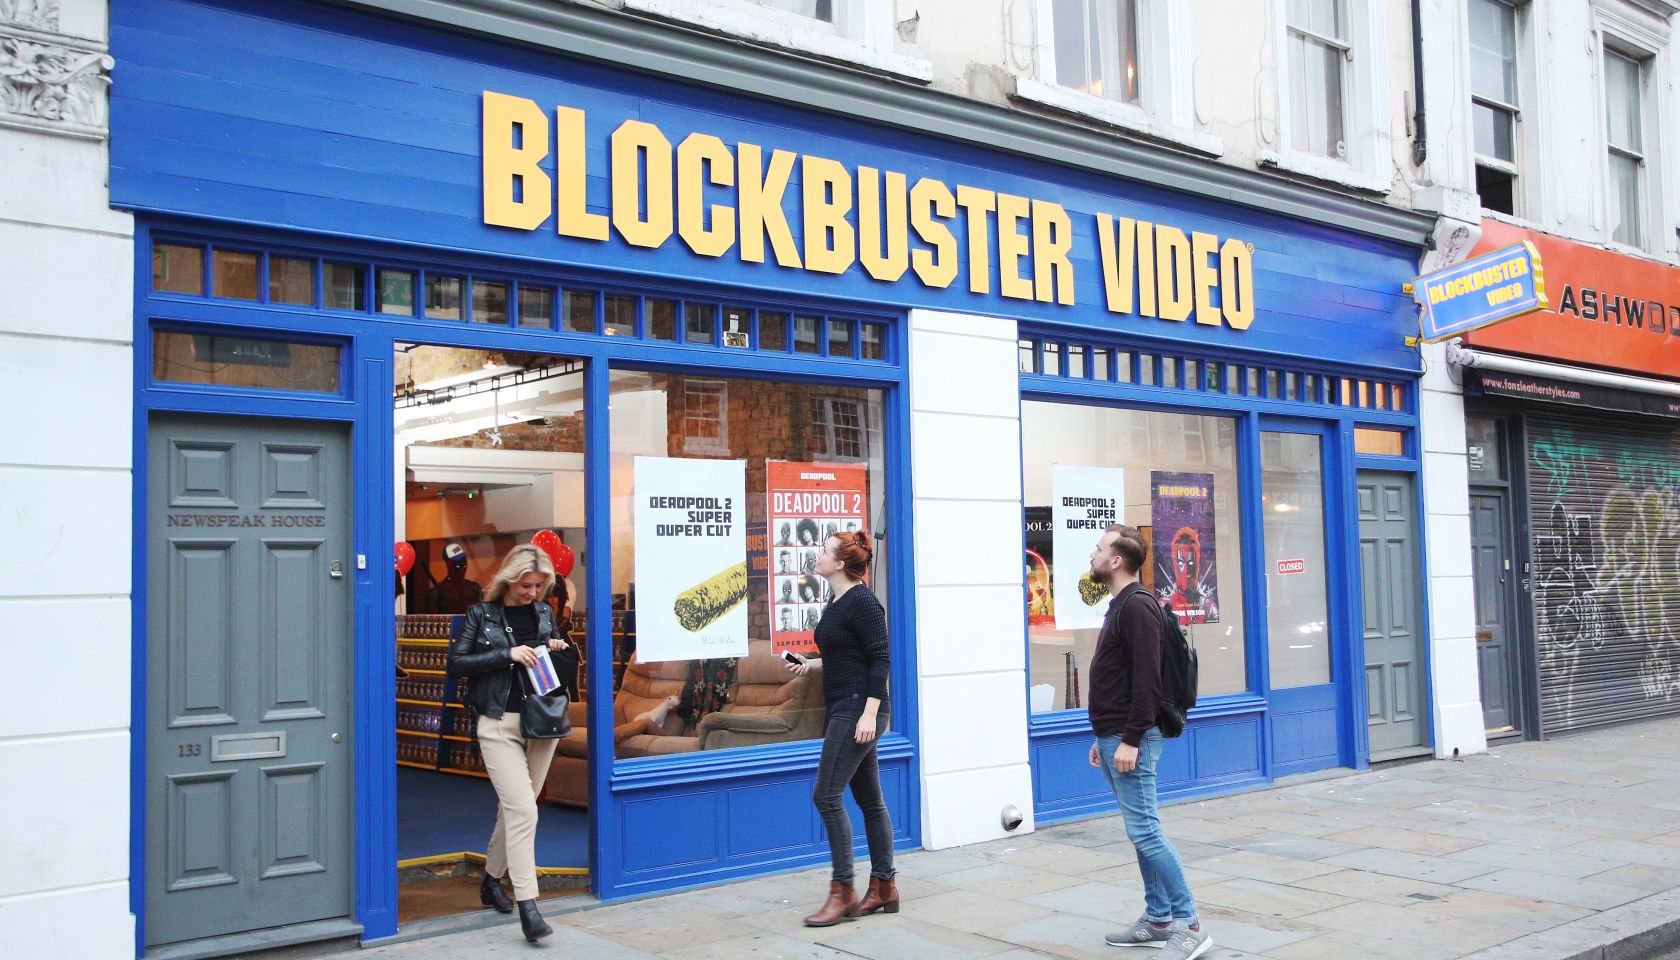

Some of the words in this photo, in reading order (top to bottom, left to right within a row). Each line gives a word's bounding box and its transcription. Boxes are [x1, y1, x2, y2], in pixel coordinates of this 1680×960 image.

[483, 90, 1075, 306] BLOCKBUSTER
[1097, 212, 1255, 330] VIDEO
[1429, 257, 1528, 305] BLOCKBUSTER
[1486, 282, 1523, 307] VIDEO
[1159, 485, 1201, 497] DEADPOOL
[1202, 487, 1208, 497] 2
[650, 496, 721, 510] DEADPOOL
[725, 498, 732, 510] 2
[773, 492, 849, 514] DEADPOOL
[853, 494, 861, 514] 2
[1062, 496, 1109, 508] DEADPOOL
[1110, 498, 1116, 509] 2
[688, 511, 732, 523] SUPER
[1086, 509, 1116, 519] SUPER
[167, 515, 266, 527] NEWSPEAK
[271, 515, 326, 527] HOUSE
[1046, 522, 1053, 531] 2
[1066, 519, 1097, 530] DUPER
[656, 524, 703, 536] DUPER
[707, 525, 732, 537] CUT
[1279, 561, 1304, 572] CLOSED
[178, 744, 202, 758] 133
